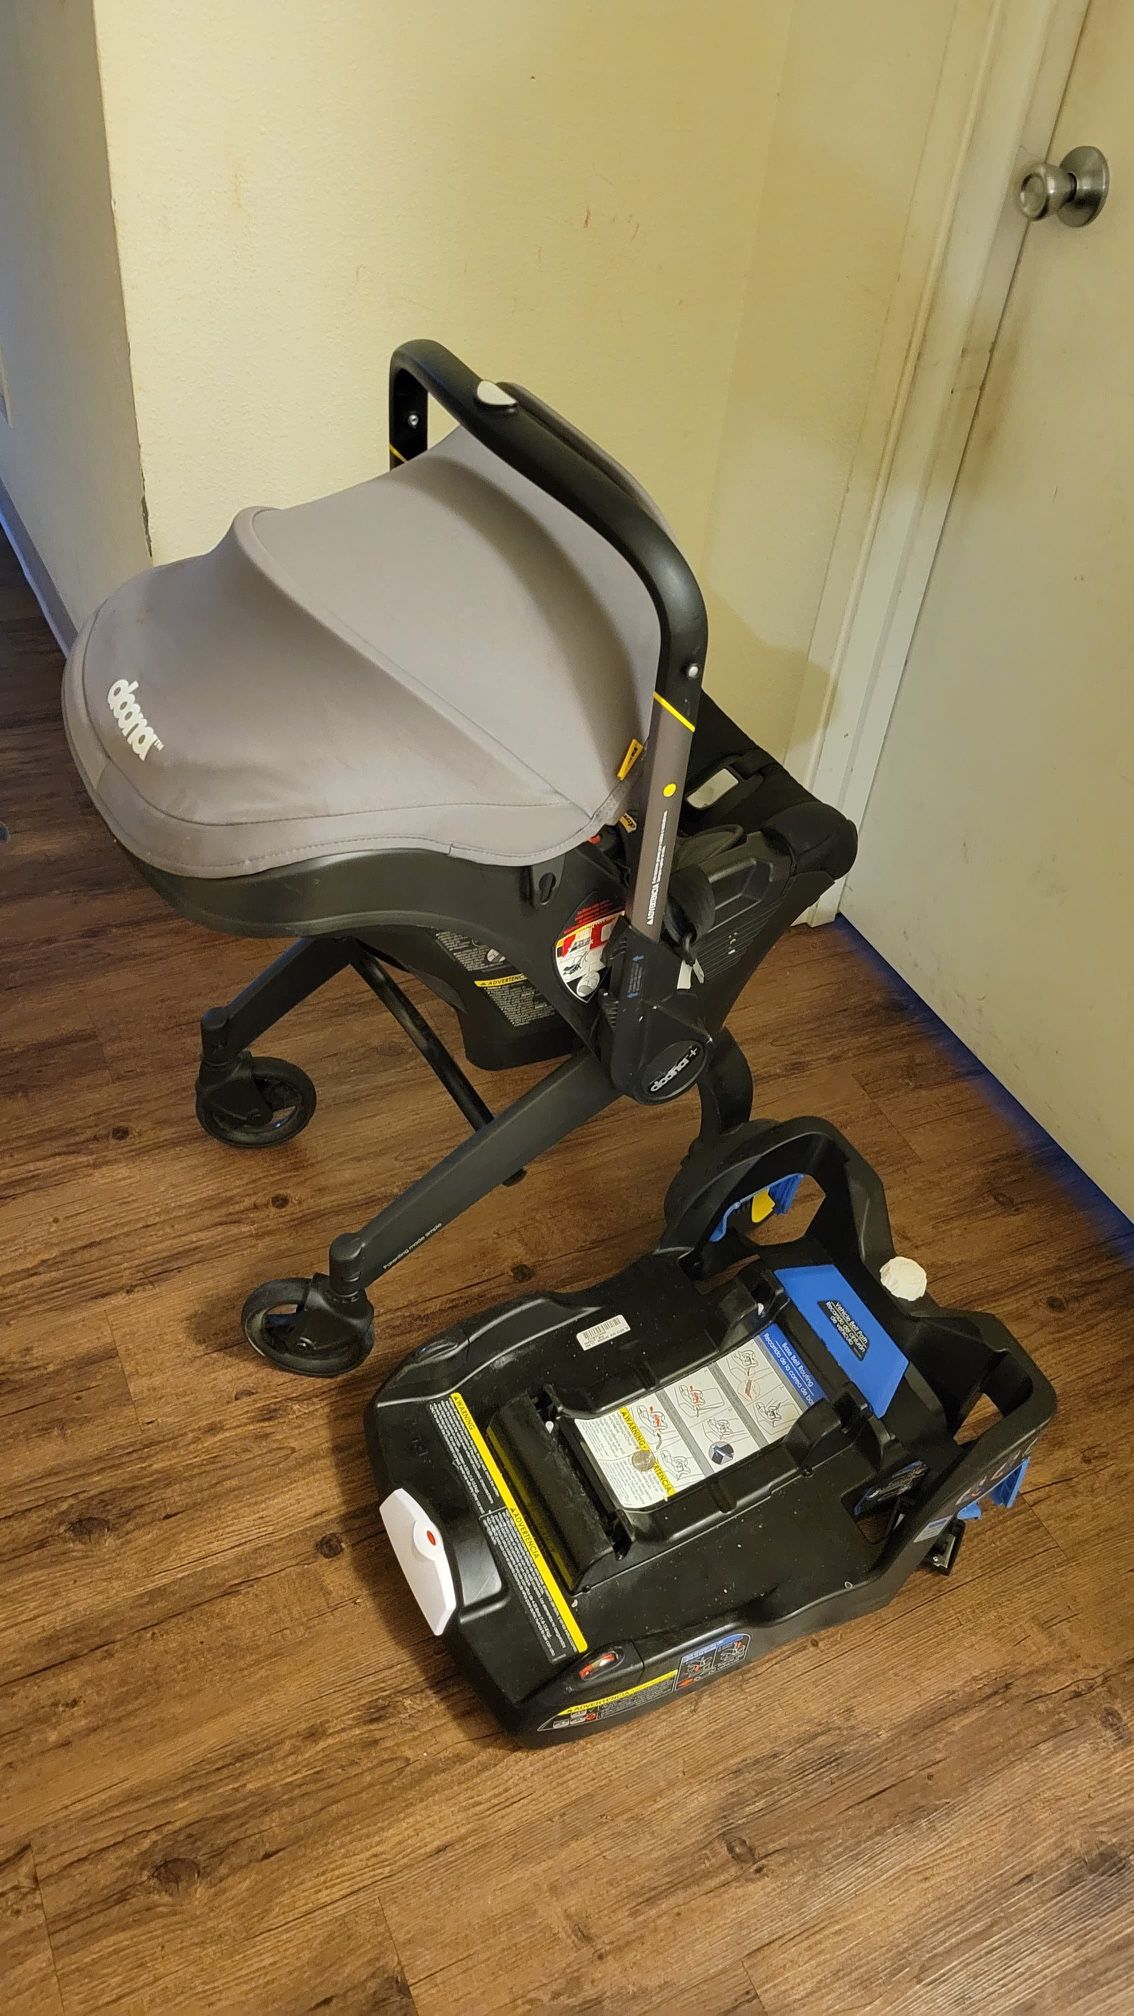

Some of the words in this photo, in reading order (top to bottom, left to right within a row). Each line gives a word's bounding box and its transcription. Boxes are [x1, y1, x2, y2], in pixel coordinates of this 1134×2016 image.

[829, 1315, 837, 1323] de
[835, 1302, 851, 1321] Vehicle
[848, 1320, 859, 1331] Belt
[856, 1330, 868, 1344] Path
[842, 1324, 851, 1333] del
[763, 1332, 782, 1358] Recorrido
[779, 1356, 787, 1365] de
[787, 1370, 802, 1388] correa
[800, 1387, 809, 1396] de
[781, 1342, 793, 1355] Base
[790, 1355, 801, 1366] Belt
[797, 1365, 814, 1387] Routing
[456, 1399, 475, 1430] WARNING
[624, 1415, 645, 1446] WARNING
[513, 1512, 540, 1559] ADVERTENCIA
